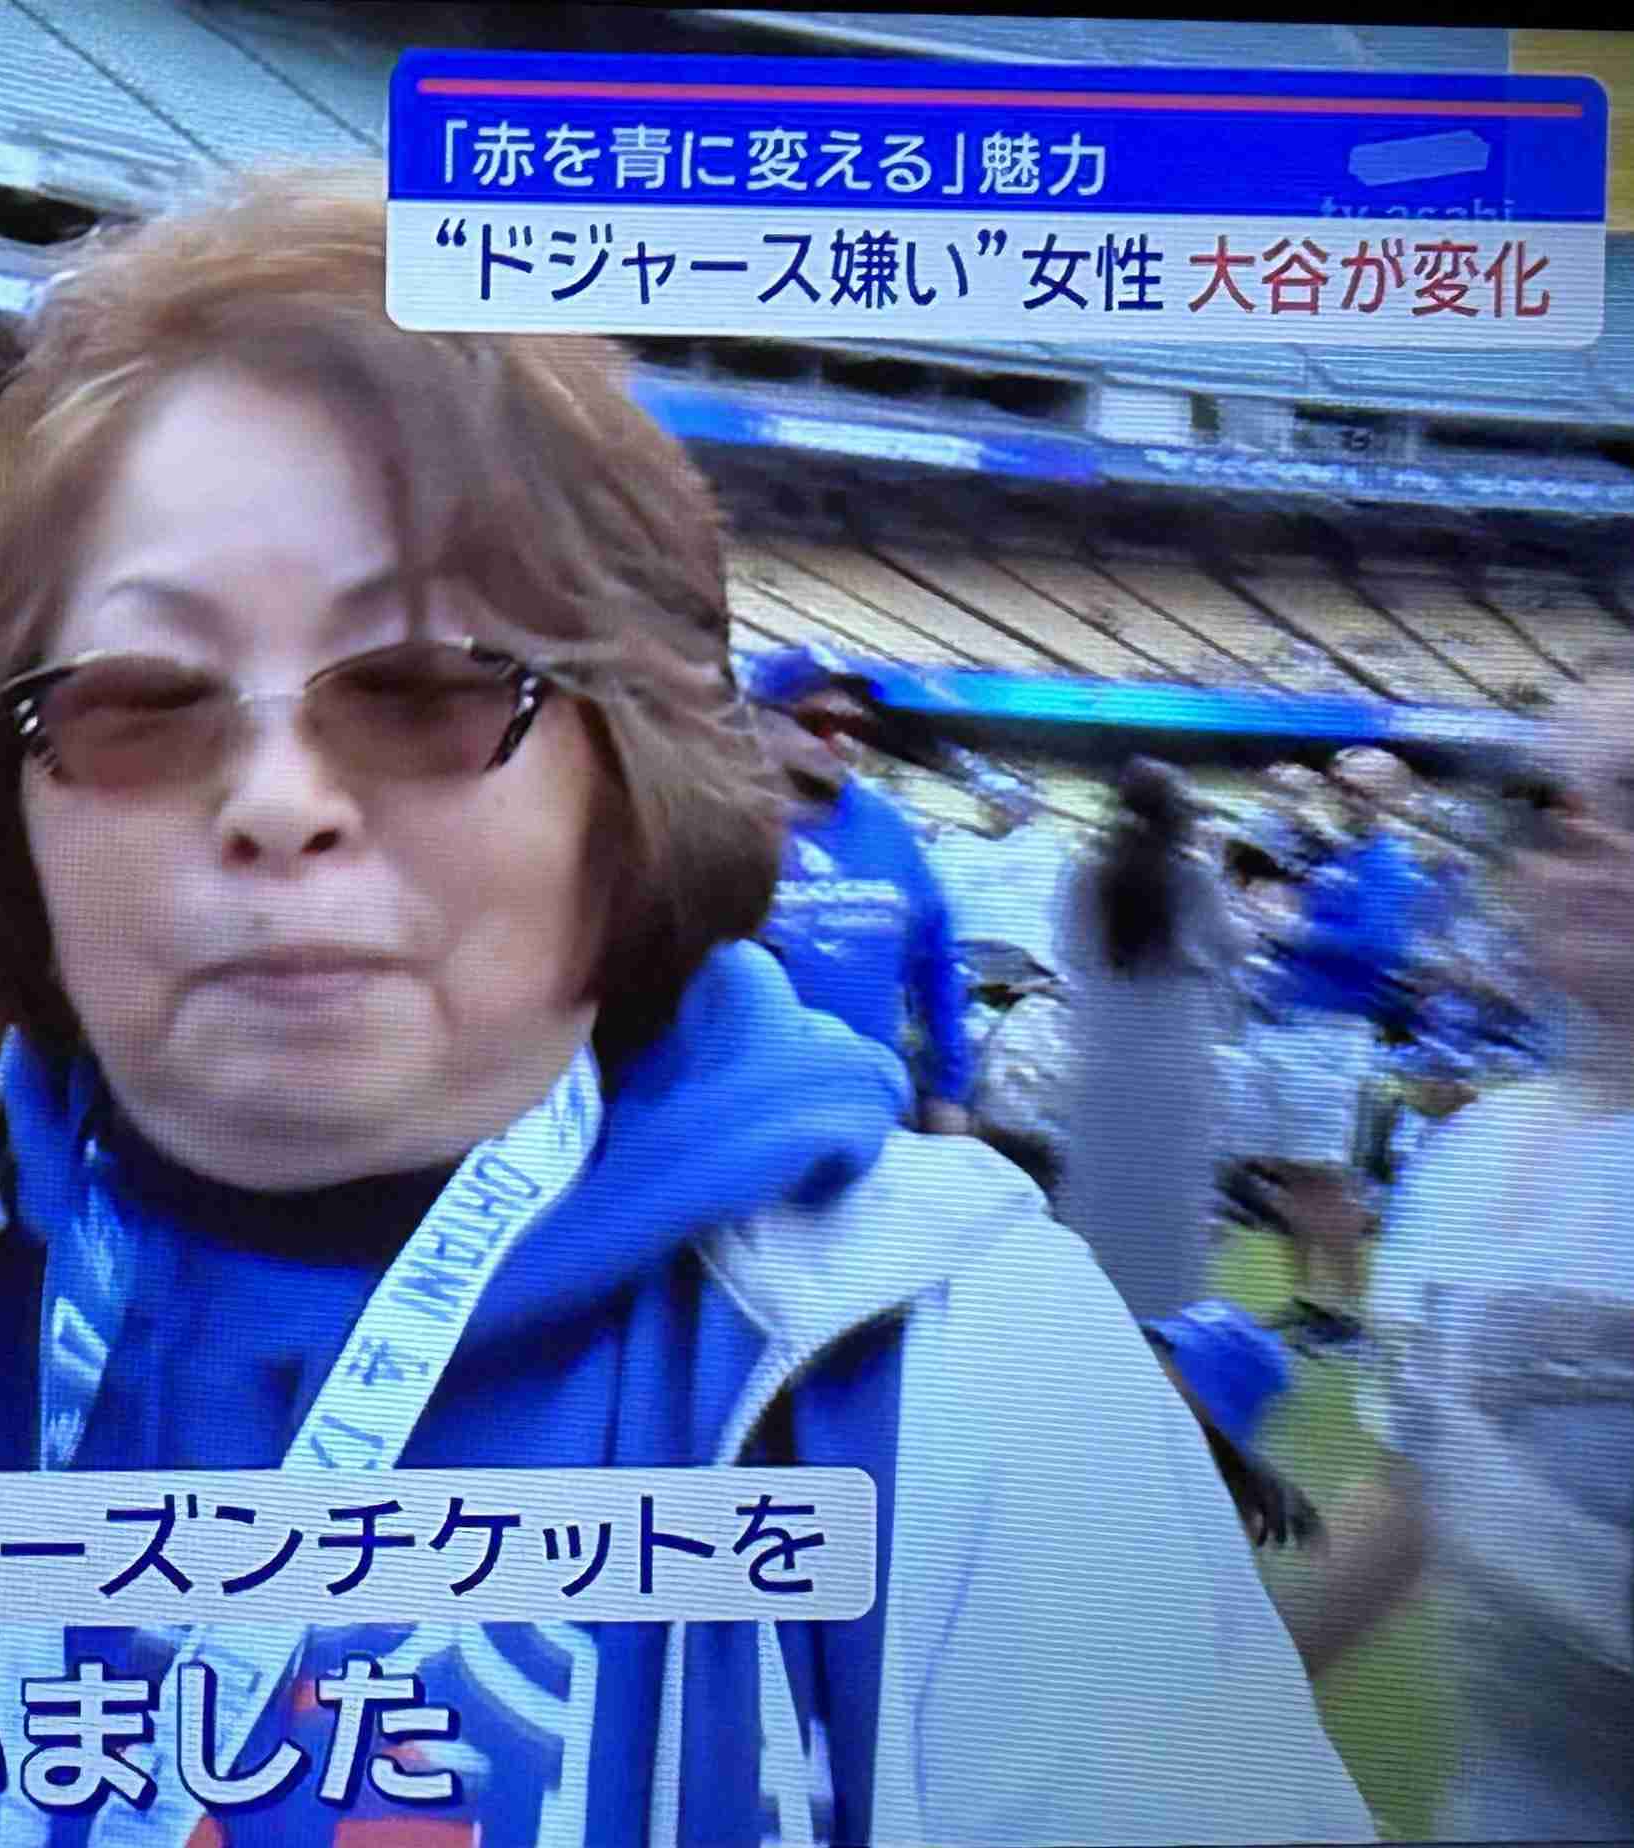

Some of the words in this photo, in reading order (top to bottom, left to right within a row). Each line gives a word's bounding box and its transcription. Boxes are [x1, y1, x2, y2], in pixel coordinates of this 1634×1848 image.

[442, 120, 1106, 194] 「赤を青に変える」魅力
[1188, 235, 1552, 318] 大谷が変化
